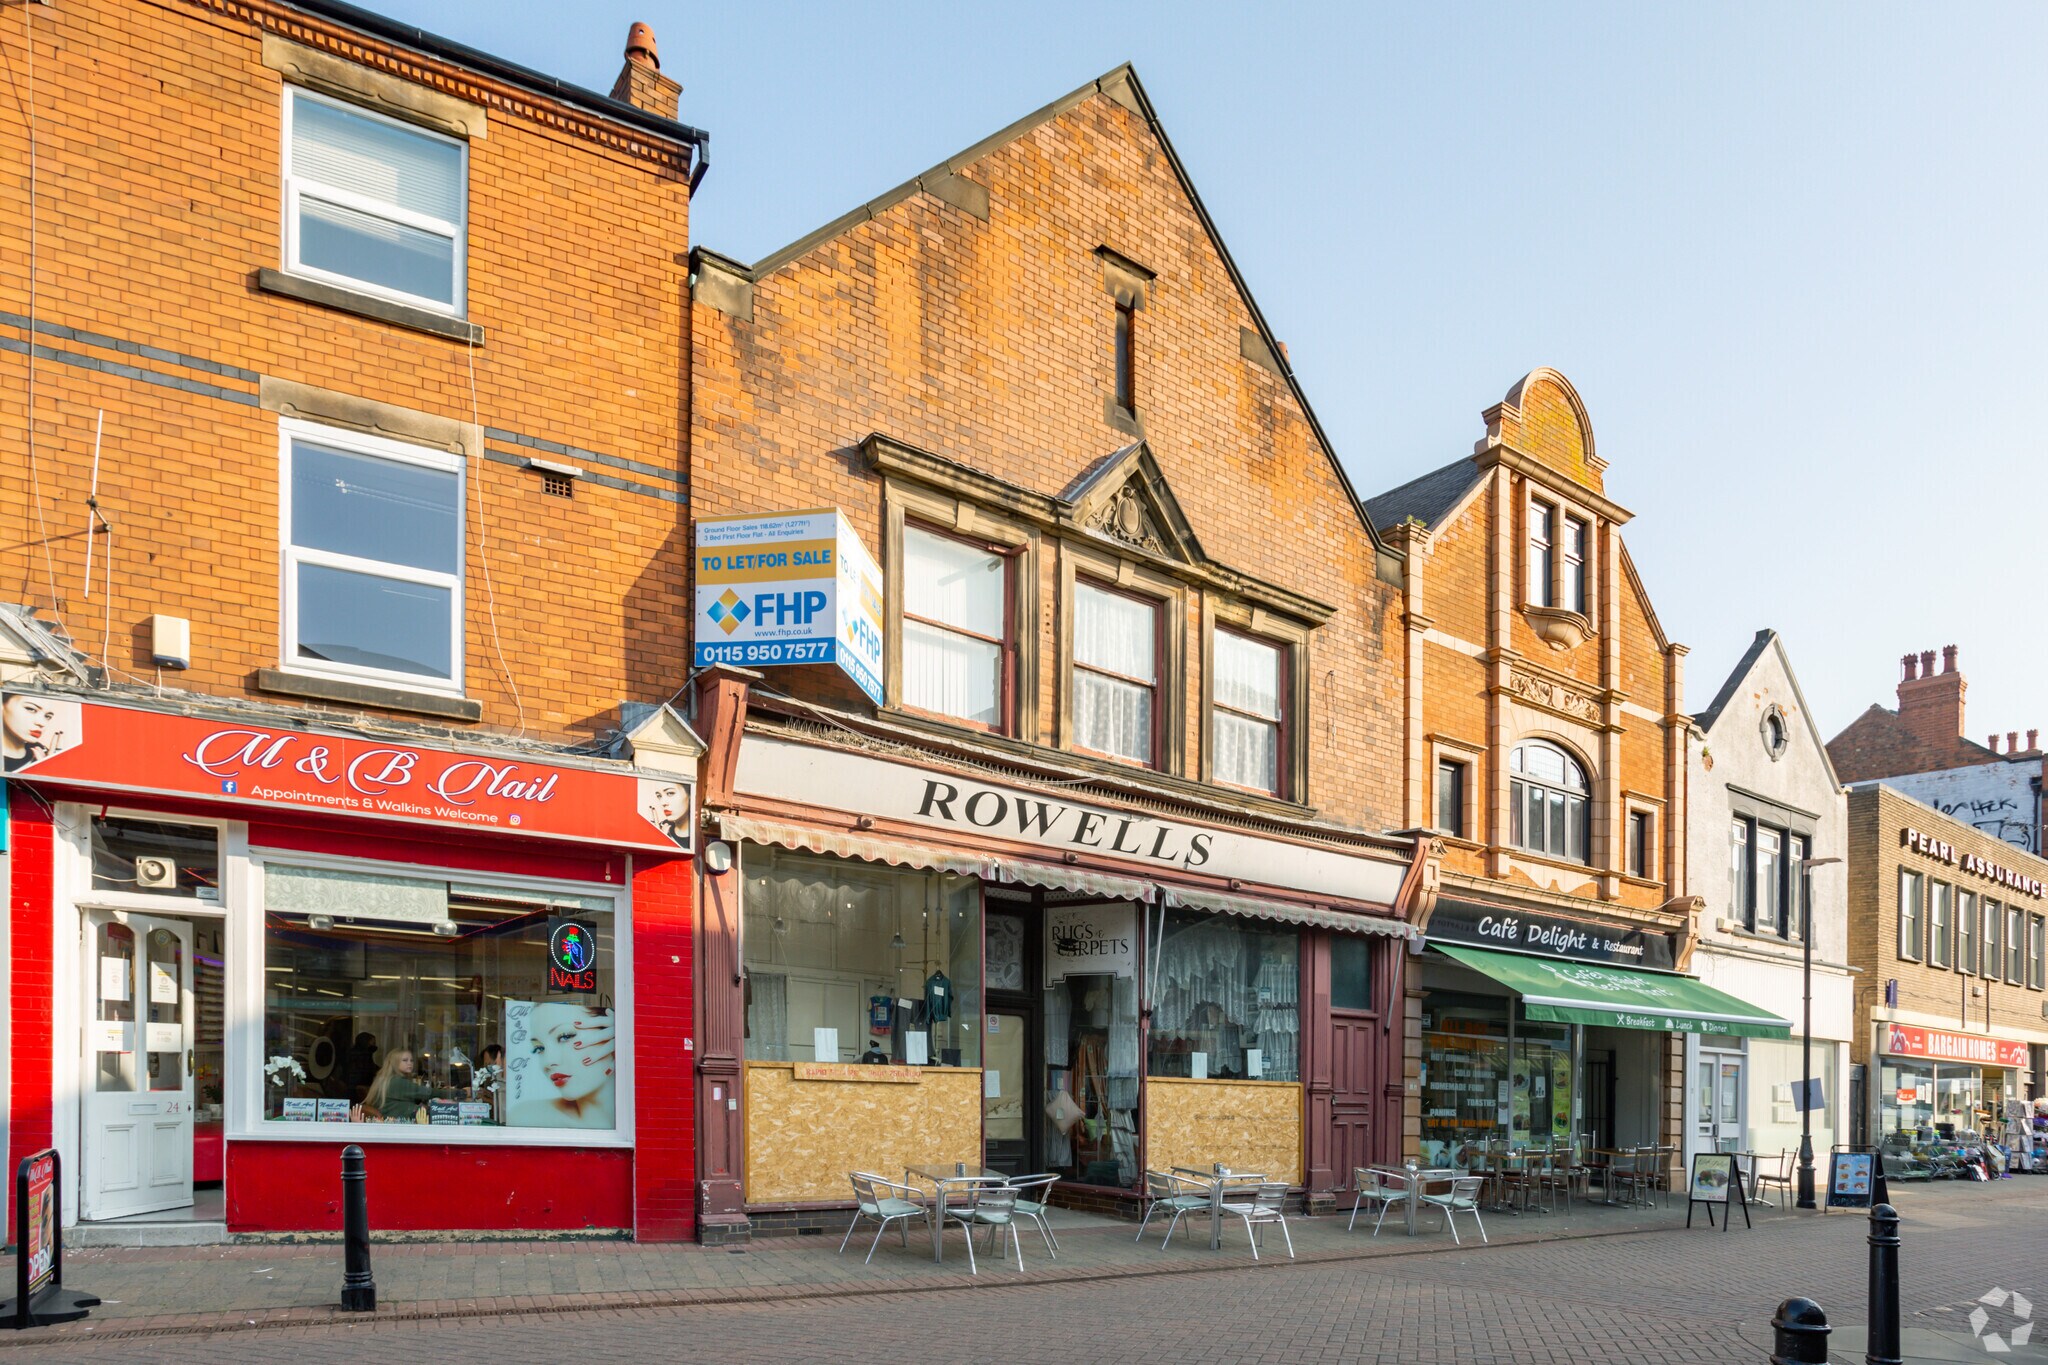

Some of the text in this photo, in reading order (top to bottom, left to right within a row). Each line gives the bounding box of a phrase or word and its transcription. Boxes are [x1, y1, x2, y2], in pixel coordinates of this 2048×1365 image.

[704, 526, 725, 534] Ground
[726, 525, 741, 533] Floor
[777, 528, 804, 537] Enquiries
[702, 549, 831, 571] TO LET/FOR SALE
[754, 590, 827, 627] FHP
[754, 626, 813, 638] www.fhp.co.uk
[859, 615, 881, 664] FHP
[703, 642, 828, 662] 0115 950 7577
[839, 647, 855, 674] 0115
[855, 661, 868, 687] 950
[867, 673, 881, 700] 7577
[182, 728, 560, 806] M & B Nail
[250, 784, 499, 824] Appointments & Walkins Welcome
[915, 778, 1214, 867] ROWELLS
[1906, 827, 2048, 899] PEARL ASSURANCE
[1052, 923, 1094, 941] RUGS
[1478, 916, 1644, 956] Café Delight & Restaurant
[550, 966, 595, 990] NAILS
[1626, 1015, 1728, 1034] Breakfast Lunch Dinner
[1430, 1053, 1443, 1061] HOT
[1927, 1032, 1997, 1061] BARGAIN HOMES
[1454, 1069, 1471, 1077] COLD
[1430, 1082, 1485, 1092] HOMEMADE FOOD
[166, 1102, 179, 1113] 24
[1466, 1098, 1496, 1107] TOASTIES
